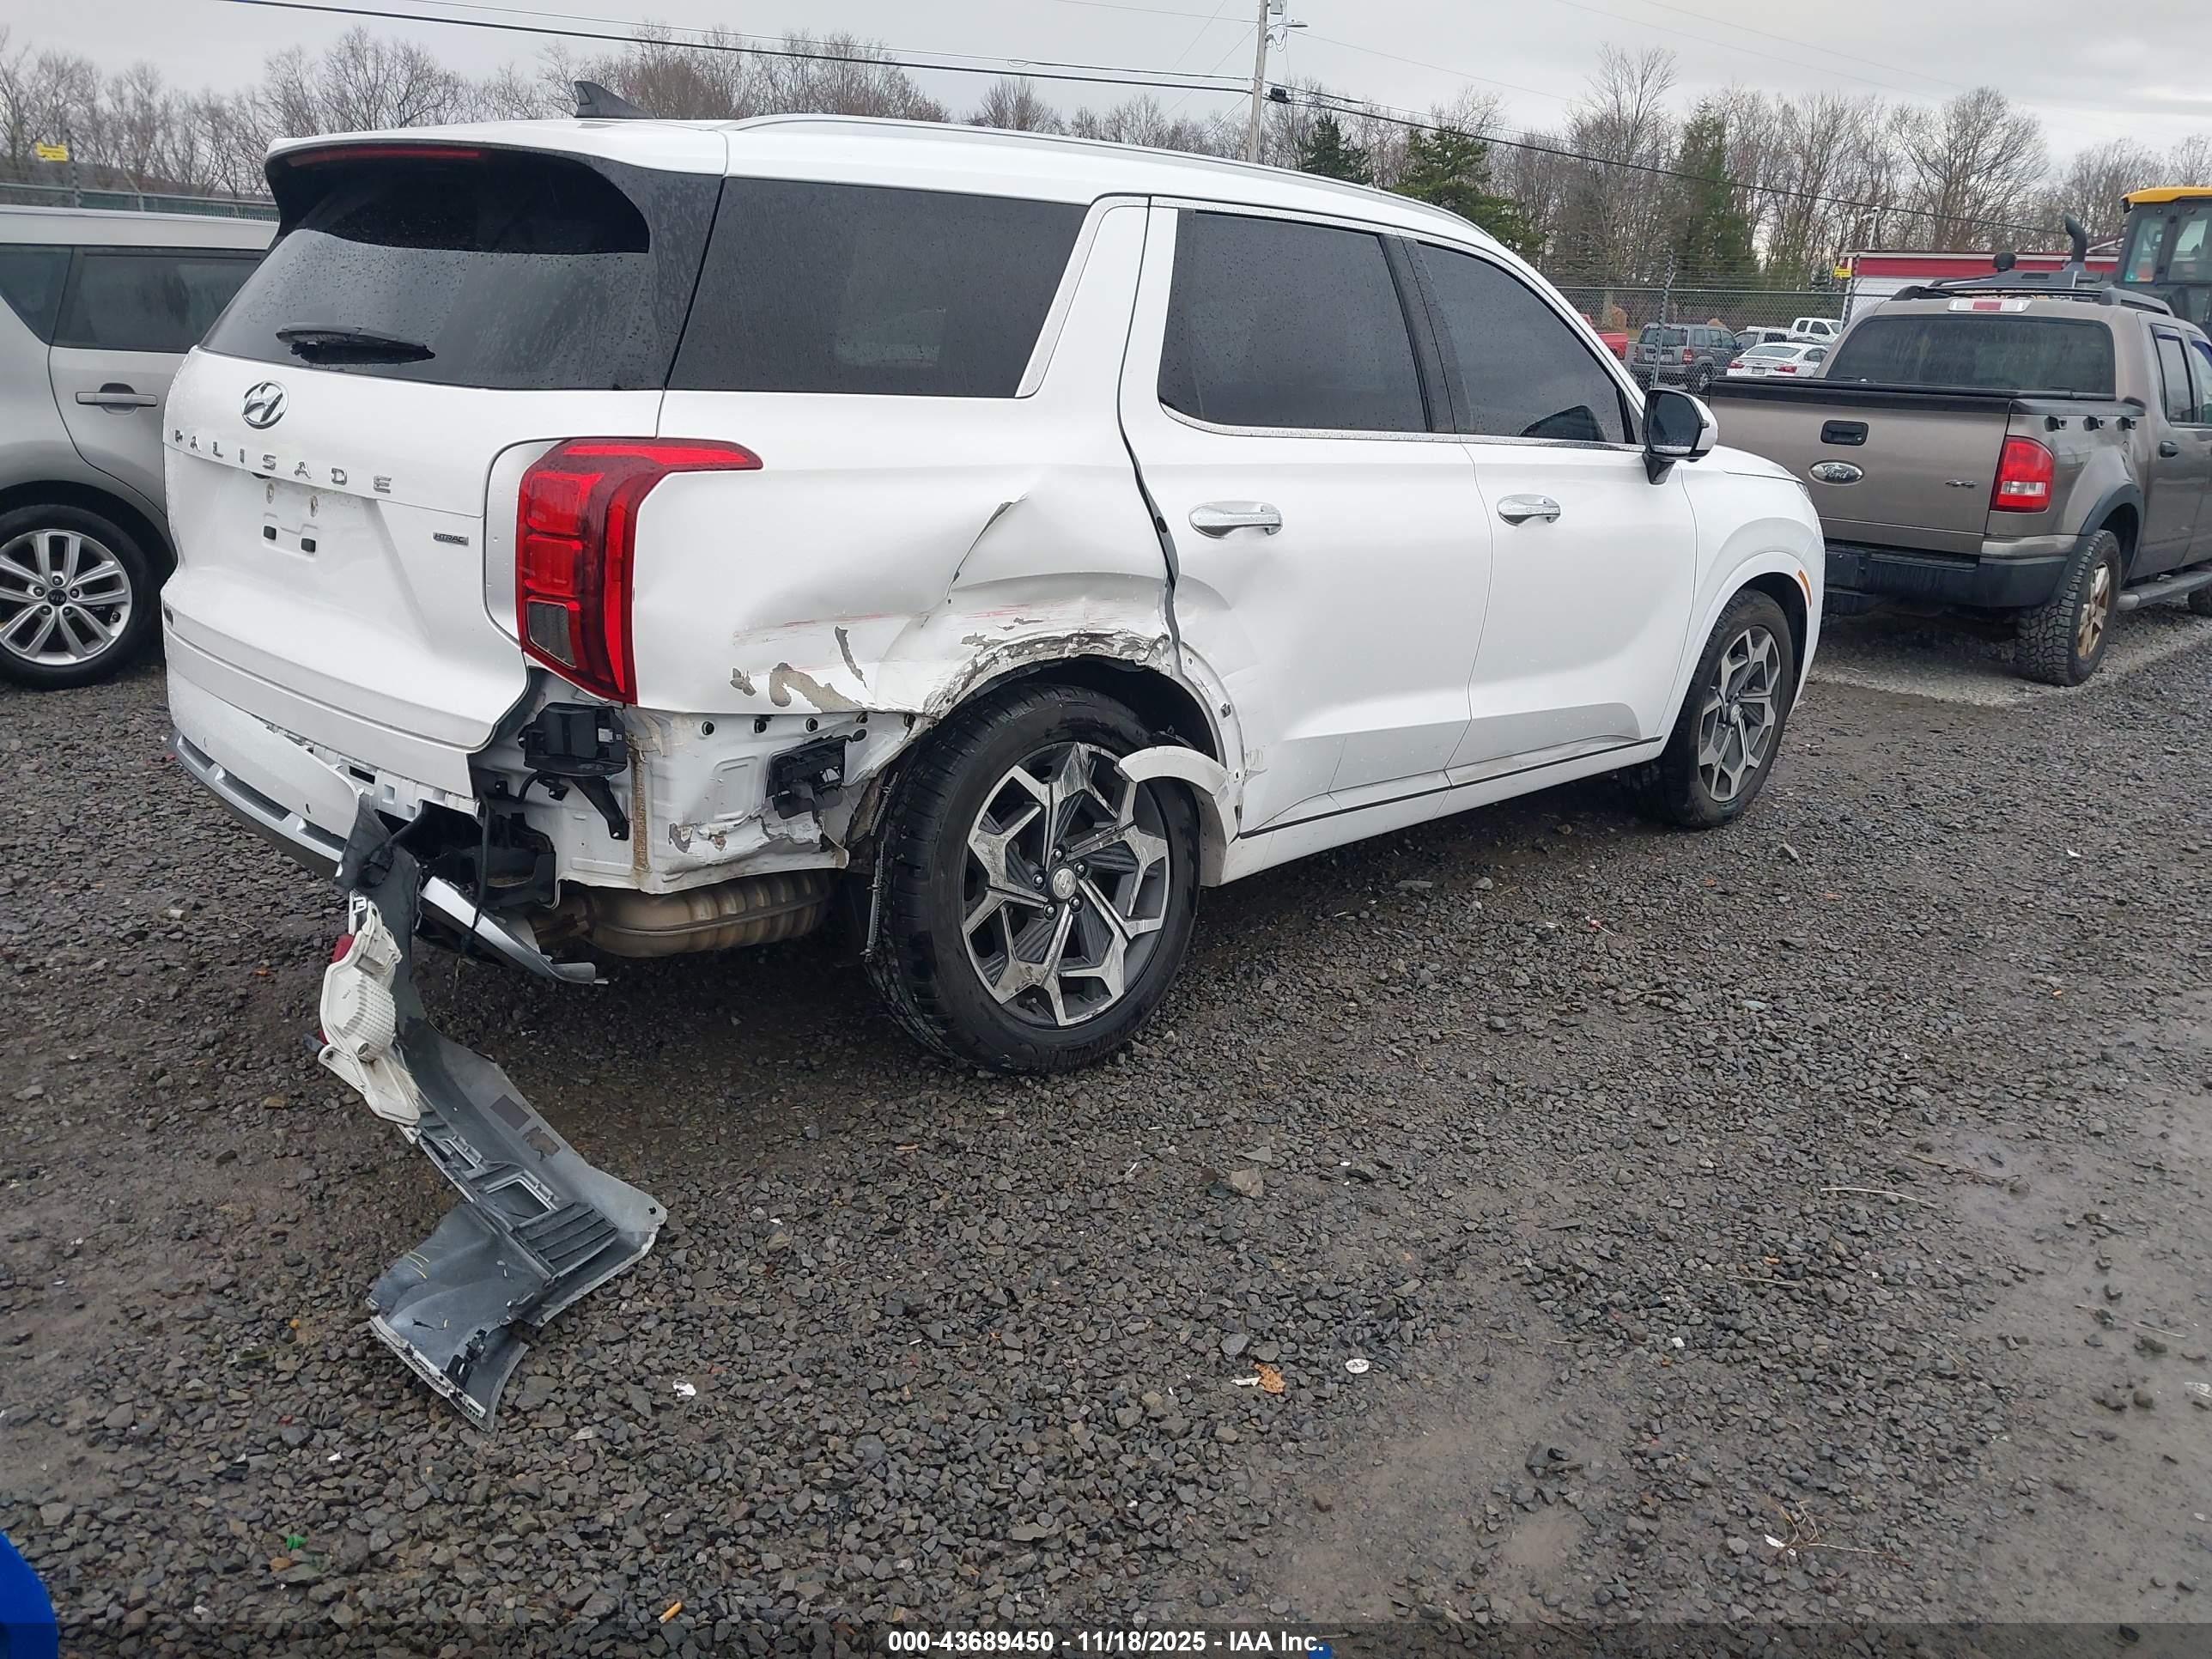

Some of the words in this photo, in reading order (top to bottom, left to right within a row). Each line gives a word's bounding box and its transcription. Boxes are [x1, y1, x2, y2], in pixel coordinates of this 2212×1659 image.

[174, 429, 392, 494] PALISADE
[1824, 465, 1850, 480] Ford
[434, 532, 466, 544] HTRAC
